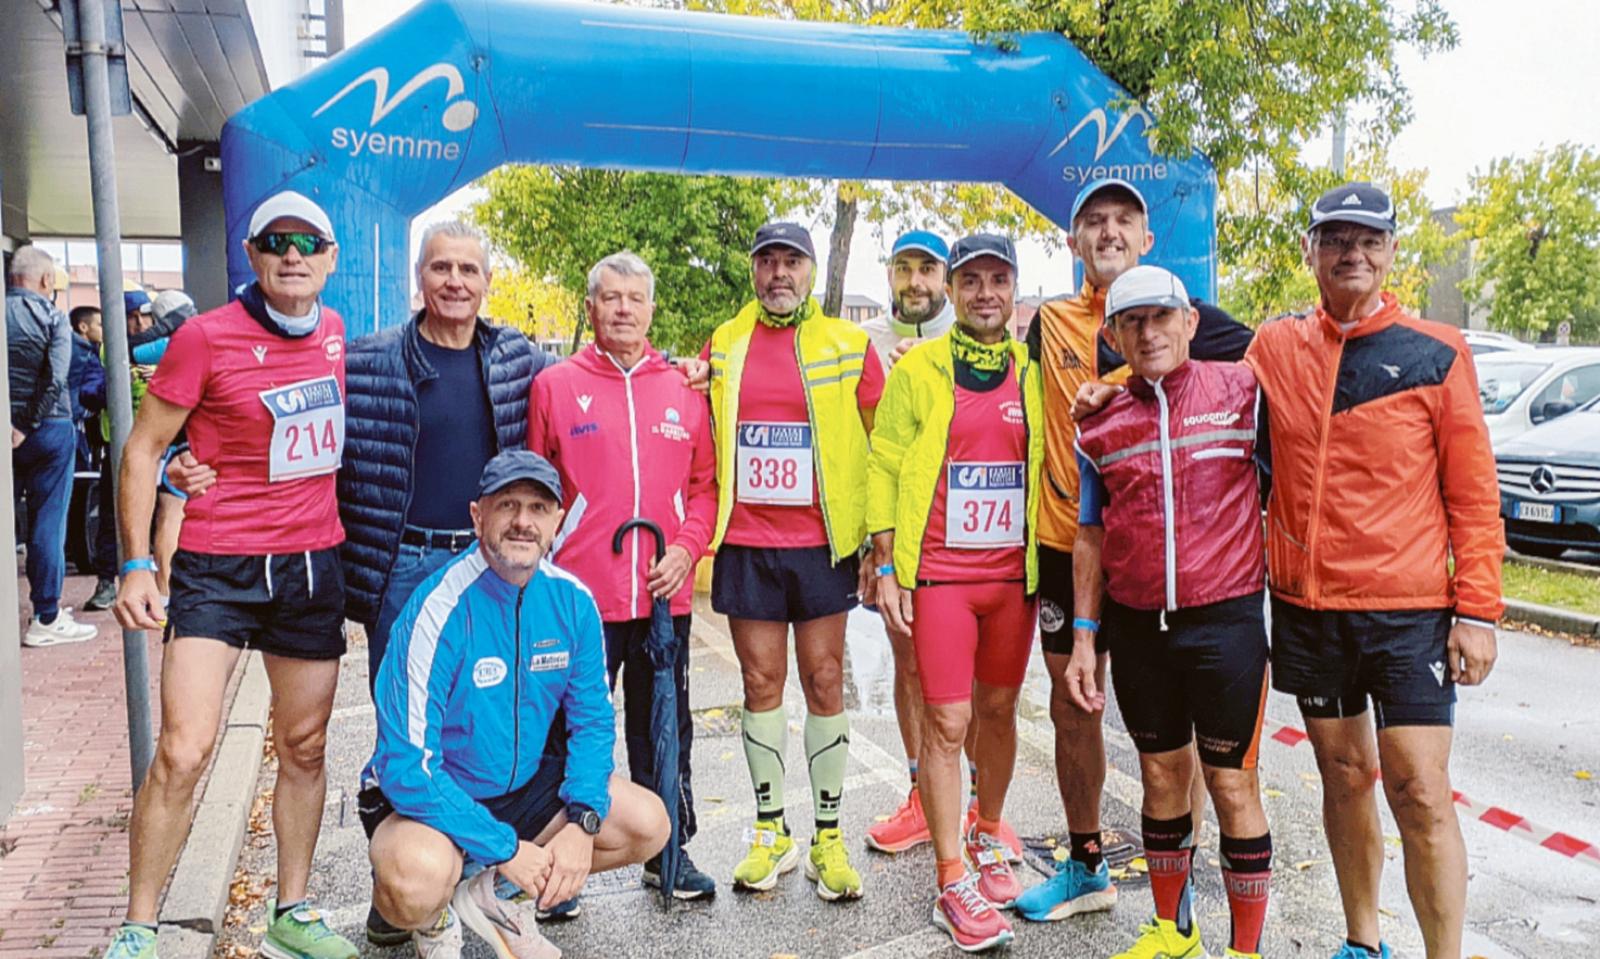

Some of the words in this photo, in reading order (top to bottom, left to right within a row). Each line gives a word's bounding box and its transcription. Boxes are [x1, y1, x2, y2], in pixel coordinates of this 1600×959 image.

[331, 127, 460, 161] syemme
[1062, 161, 1168, 186] syemme
[284, 418, 338, 462] 214
[749, 457, 798, 490] 338
[963, 499, 1012, 533] 374
